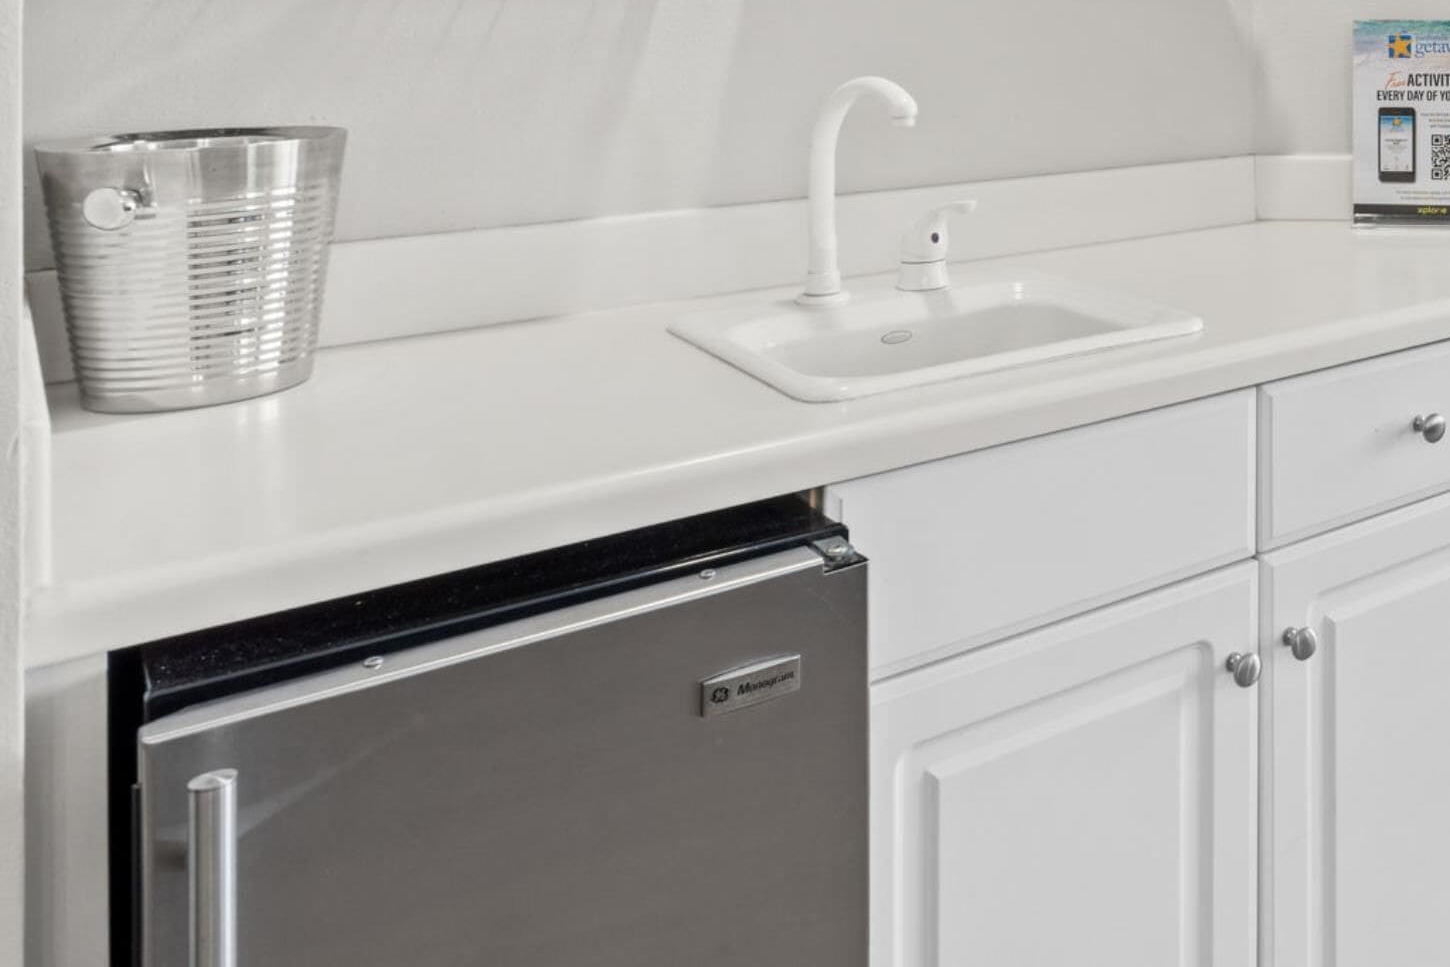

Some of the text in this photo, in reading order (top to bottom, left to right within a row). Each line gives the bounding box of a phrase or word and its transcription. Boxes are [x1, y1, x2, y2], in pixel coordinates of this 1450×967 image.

[1376, 90, 1405, 101] EVERY
[1407, 90, 1424, 101] DAY
[1426, 90, 1438, 101] OF
